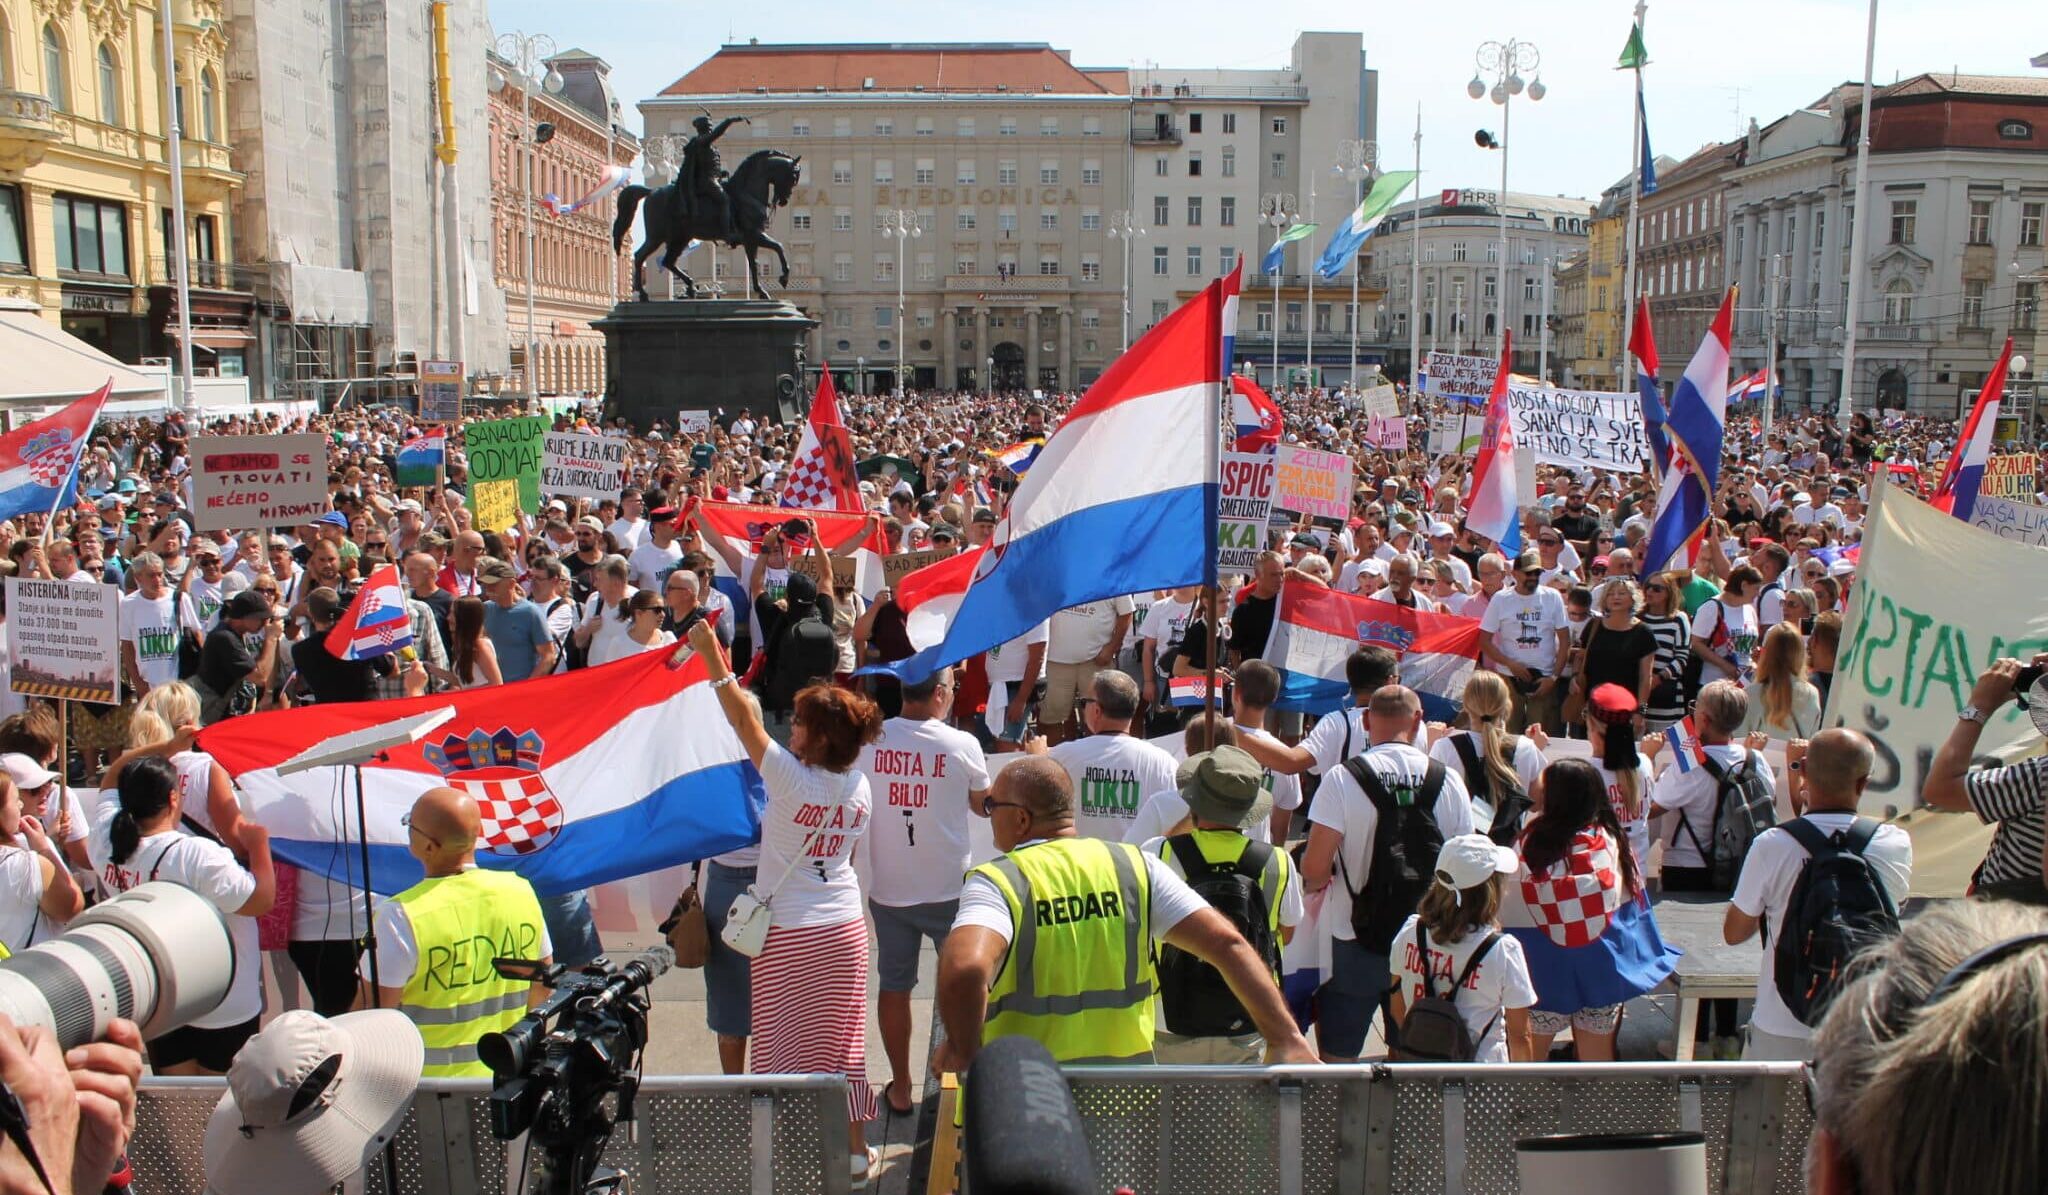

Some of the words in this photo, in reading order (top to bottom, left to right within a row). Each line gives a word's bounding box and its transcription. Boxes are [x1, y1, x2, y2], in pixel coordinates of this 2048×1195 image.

[1462, 192, 1497, 204] HPB
[1509, 389, 1551, 411] DOSTA
[1555, 393, 1603, 418] ODGODA
[1611, 398, 1614, 419] I
[467, 421, 544, 446] SANACIJA
[1519, 411, 1598, 437] SANACIJA
[543, 438, 577, 458] VRIJEME
[589, 441, 600, 460] ZA
[1517, 435, 1571, 457] HITNO
[1579, 438, 1600, 459] SE
[231, 455, 272, 469] DAMO
[291, 454, 311, 464] SE
[219, 471, 311, 485] TROVATI
[552, 467, 563, 487] ZA
[2005, 476, 2013, 494] U
[2017, 475, 2034, 494] HR
[207, 490, 269, 508] NEĆEMO
[260, 502, 328, 518] MIROVATI
[1219, 497, 1269, 519] SMETLIŠTE!
[1976, 502, 2015, 524] NAŠA
[885, 556, 910, 573] SAD
[18, 581, 69, 600] HISTERIČNA
[72, 588, 102, 603] (pridjev)
[18, 602, 38, 616] Stanje
[47, 604, 60, 617] koje
[63, 607, 73, 616] me
[75, 606, 104, 618] dovodite
[18, 616, 34, 627] kada
[62, 619, 77, 630] tona
[19, 631, 45, 643] opasnog
[47, 633, 69, 644] otpada
[71, 635, 97, 646] nazivate
[140, 633, 177, 658] LIKU
[874, 750, 923, 777] DOSTA
[932, 753, 946, 778] JE
[1086, 766, 1117, 784] HODAJ
[1121, 769, 1135, 785] ZA
[888, 782, 928, 808] BILO!
[1081, 777, 1139, 809] LIKU
[1036, 891, 1120, 927] REDAR
[424, 922, 536, 991] REDAR
